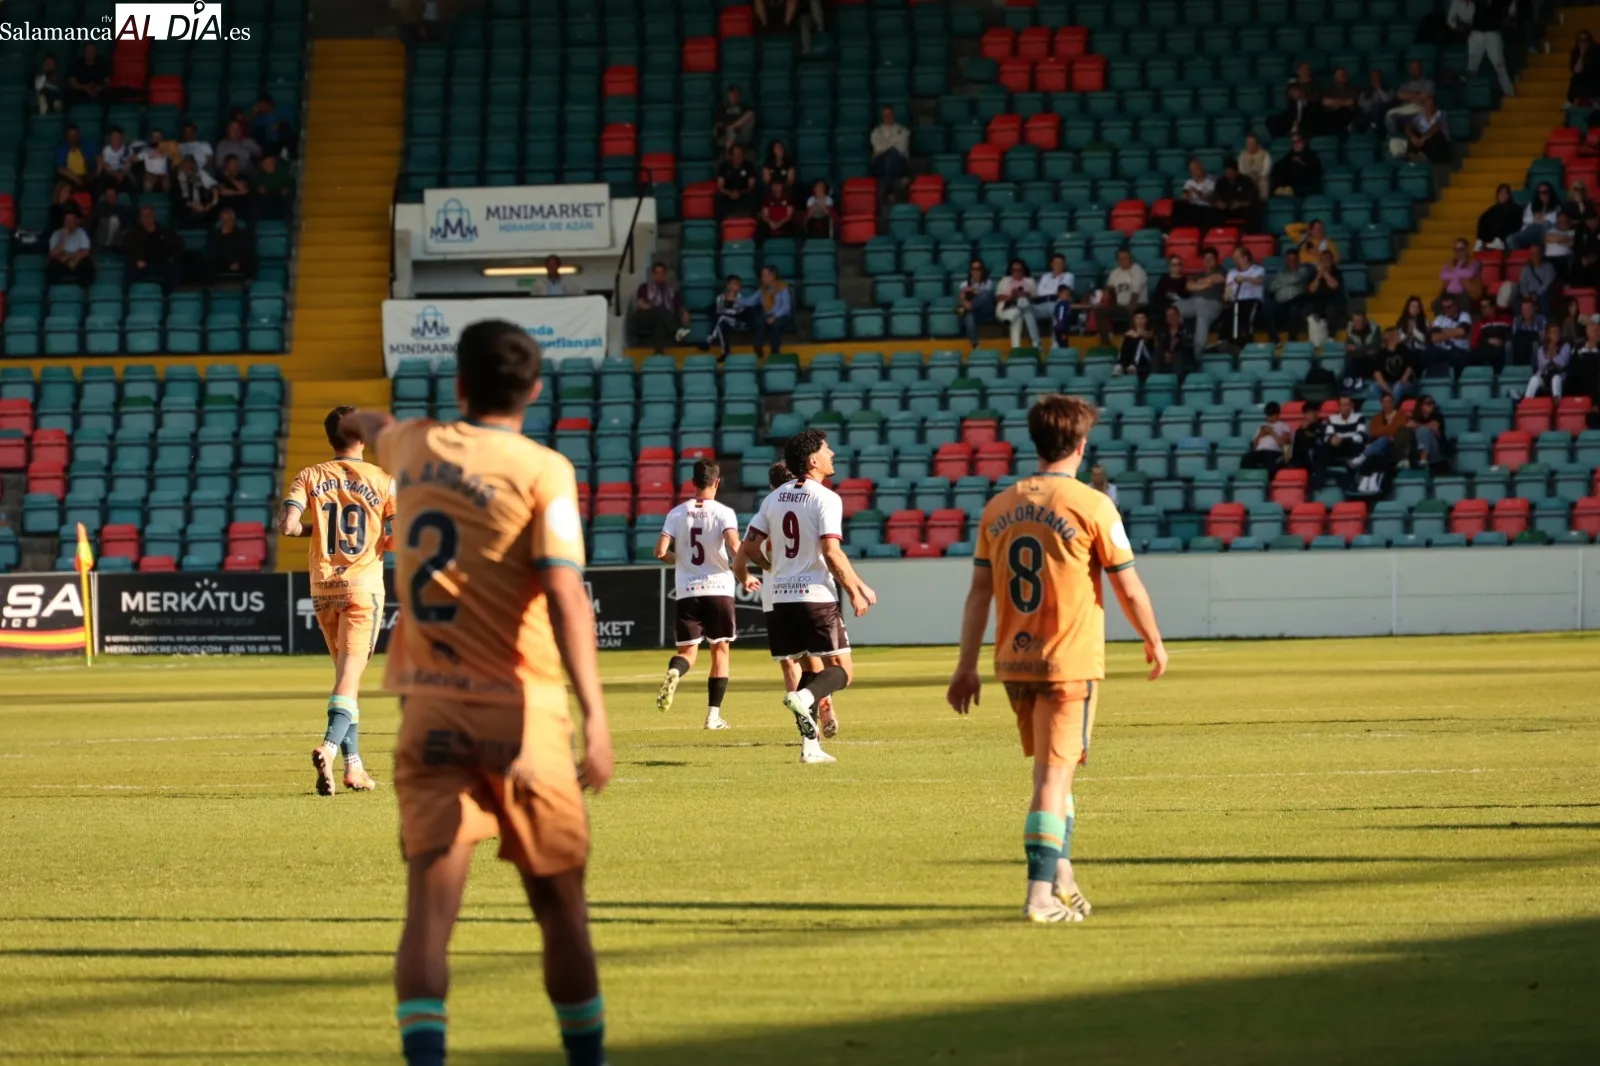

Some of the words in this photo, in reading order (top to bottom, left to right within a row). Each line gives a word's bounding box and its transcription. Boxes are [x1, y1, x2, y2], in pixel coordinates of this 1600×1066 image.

[485, 203, 605, 221] MINIMARKET
[388, 343, 458, 356] MINIMARK
[344, 480, 380, 507] RAMOS
[777, 492, 811, 504] SERVETTI
[322, 503, 367, 556] 19
[690, 527, 705, 566] 5
[782, 510, 801, 559] 9
[406, 509, 460, 622] 2
[1008, 535, 1044, 614] 8
